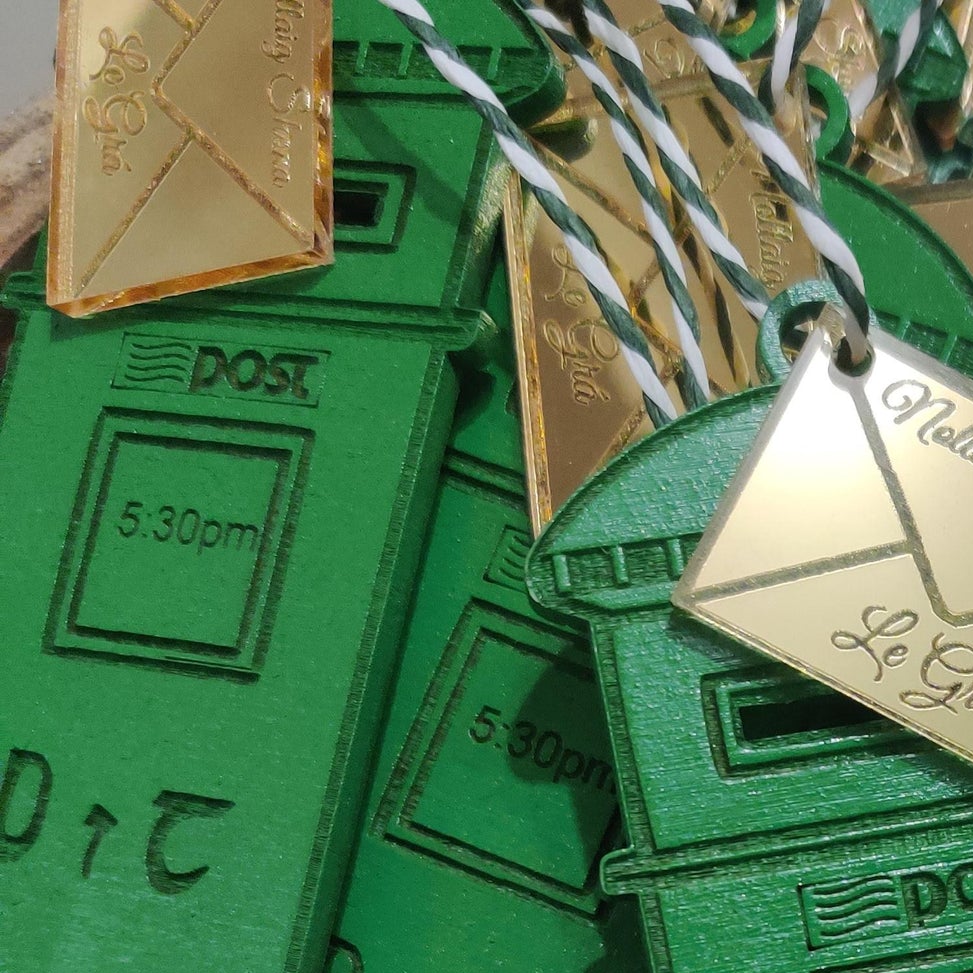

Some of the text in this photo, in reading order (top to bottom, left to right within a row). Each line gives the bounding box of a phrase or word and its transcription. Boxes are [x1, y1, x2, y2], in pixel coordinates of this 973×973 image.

[83, 26, 151, 177] Le Grá
[261, 0, 312, 189] llaig Shona
[189, 344, 320, 401] POST
[116, 500, 262, 555] 5:30pm
[830, 605, 920, 681] Le
